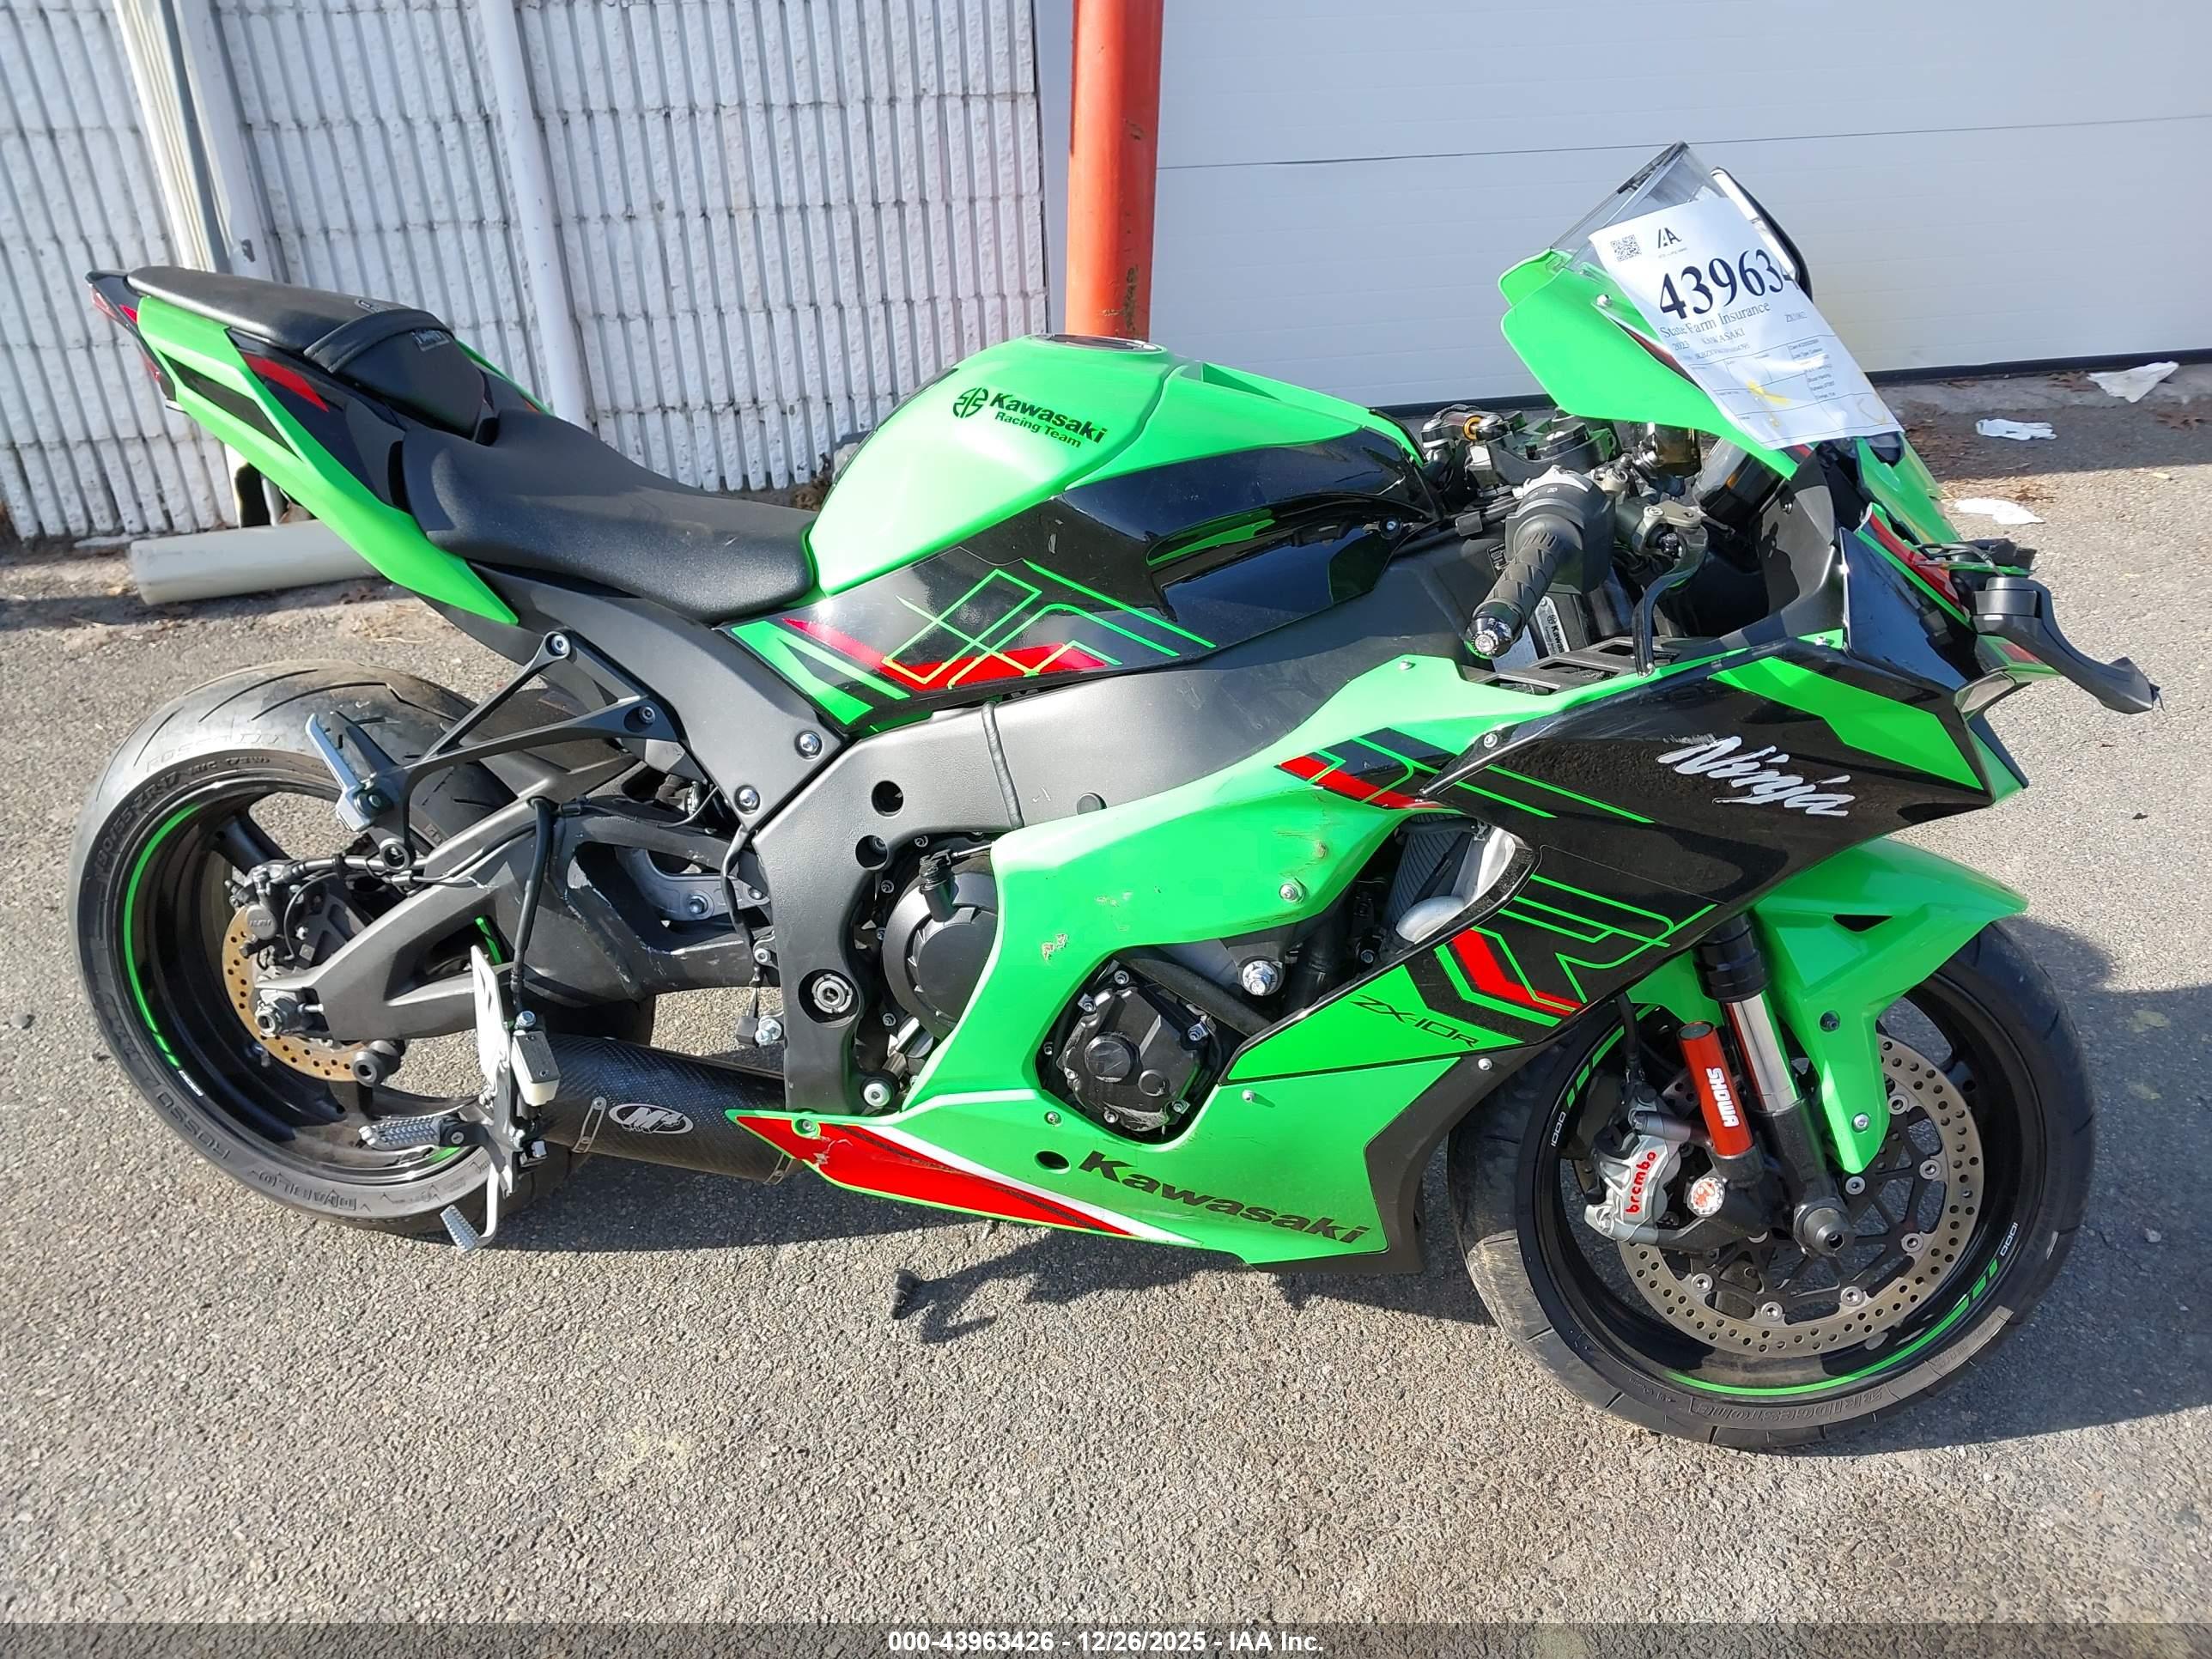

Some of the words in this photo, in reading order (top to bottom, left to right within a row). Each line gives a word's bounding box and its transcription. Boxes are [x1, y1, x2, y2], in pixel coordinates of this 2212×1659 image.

[1659, 325, 1686, 338] State
[1685, 319, 1717, 334] Farm
[1717, 302, 1771, 325] Insurance
[989, 392, 1108, 443] Kawasaki
[994, 411, 1042, 433] Racing
[1043, 425, 1082, 447] Team
[1656, 735, 1856, 816] Ninja
[1349, 994, 1480, 1048] ZX-10R
[1705, 1067, 1740, 1127] SHOWA
[156, 1091, 231, 1160] ROSSO
[1551, 1111, 1567, 1147] 1000
[1078, 1150, 1371, 1244] Kawasaki
[1626, 1151, 1657, 1213] brembo
[2000, 1222, 2019, 1257] 1000
